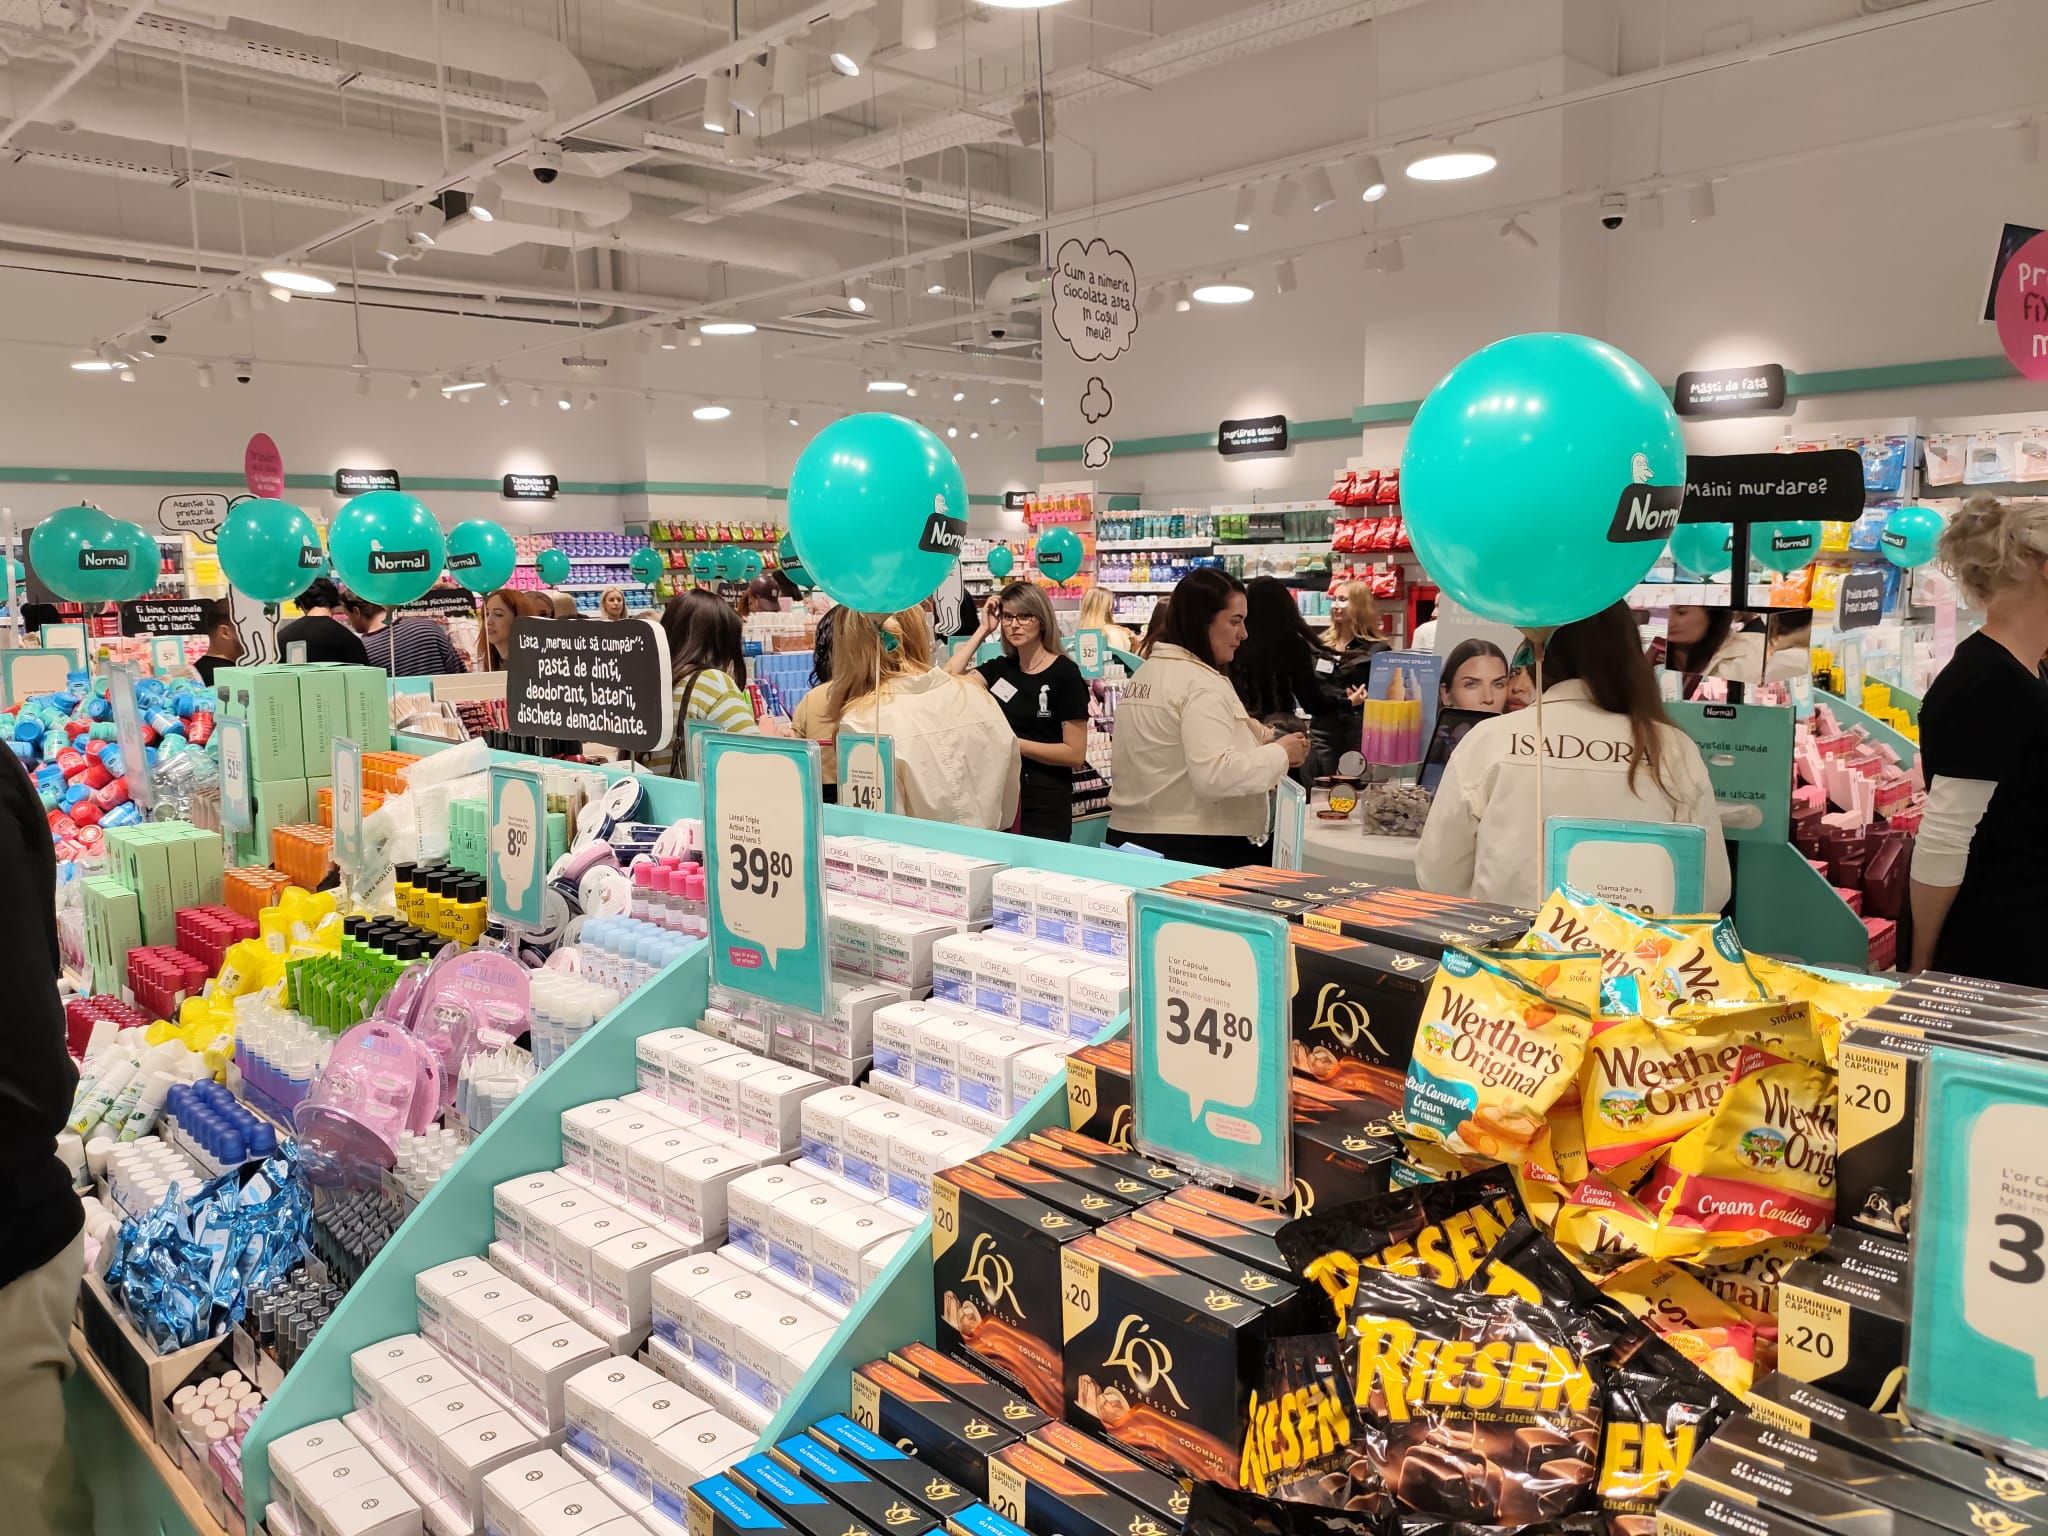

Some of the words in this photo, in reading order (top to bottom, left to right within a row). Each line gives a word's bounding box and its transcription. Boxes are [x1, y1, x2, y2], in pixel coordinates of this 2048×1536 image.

[1064, 263, 1085, 280] Cum
[1089, 272, 1095, 284] a
[1098, 274, 1129, 293] nimerit
[1111, 296, 1130, 311] asta
[1086, 326, 1111, 342] meu?!
[1739, 478, 1828, 495] murdare?
[1775, 538, 1810, 550] Normal
[85, 553, 127, 567] Normal
[374, 555, 425, 571] Normal
[139, 614, 170, 622] lucruri
[519, 634, 539, 649] Lista
[574, 636, 587, 650] uit
[589, 637, 599, 651] să
[538, 656, 571, 678] pastă
[574, 656, 588, 678] de
[591, 657, 622, 682] dinți,
[526, 678, 588, 706] deodorant,
[590, 682, 636, 711] baterii,
[517, 702, 563, 727] dischete
[566, 707, 648, 736] demachiante.
[1706, 707, 1734, 717] Normal
[1735, 744, 1768, 753] umede
[1730, 790, 1767, 800] uscate
[507, 828, 528, 857] 8,00
[730, 843, 793, 898] 39,80
[1596, 891, 1627, 901] Asortata
[1168, 955, 1180, 967] L'or
[1182, 959, 1209, 972] Capsule
[1168, 965, 1197, 979] Espresso
[1198, 972, 1232, 988] Colombia
[1168, 975, 1189, 987] 20buc
[1569, 974, 1592, 983] STORCK
[1182, 988, 1202, 1001] multe
[1203, 994, 1231, 1009] variante
[1166, 996, 1253, 1059] 34,80
[1309, 982, 1390, 1057] L'OR
[1442, 985, 1564, 1075] Werther's
[1769, 1011, 1805, 1026] STORCK
[1320, 1039, 1380, 1064] ESPRESSO
[1845, 1052, 1900, 1071] ALUMINIUM
[1452, 1033, 1548, 1099] Original
[1845, 1060, 1889, 1077] CAPSULES
[1070, 1084, 1091, 1107] x20
[1413, 1095, 1445, 1116] Cream
[1426, 1084, 1470, 1111] Caramel
[1844, 1084, 1891, 1114] x20
[2002, 1168, 2030, 1182] L'or
[1581, 1194, 1616, 1208] Candies
[1583, 1185, 1612, 1198] Cream
[933, 1207, 954, 1233] x20
[1698, 1195, 1756, 1217] Cream
[1759, 1199, 1812, 1229] Candies
[961, 1232, 1026, 1319] L'OR
[1064, 1254, 1095, 1274] ALUMINIUM
[1064, 1260, 1089, 1279] CAPSULES
[1065, 1285, 1091, 1312] x20
[1785, 1292, 1842, 1317] ALUMINIUM
[969, 1293, 1017, 1328] ESPRESSO
[1785, 1300, 1831, 1321] CAPSULES
[1785, 1326, 1834, 1359] x20
[1018, 1344, 1052, 1368] COLOMBIA
[1102, 1313, 1190, 1410] L'OR
[1354, 1314, 1595, 1424] RIESEN
[1114, 1378, 1177, 1418] ESPRESSO
[1178, 1437, 1224, 1464] COLOMBIA
